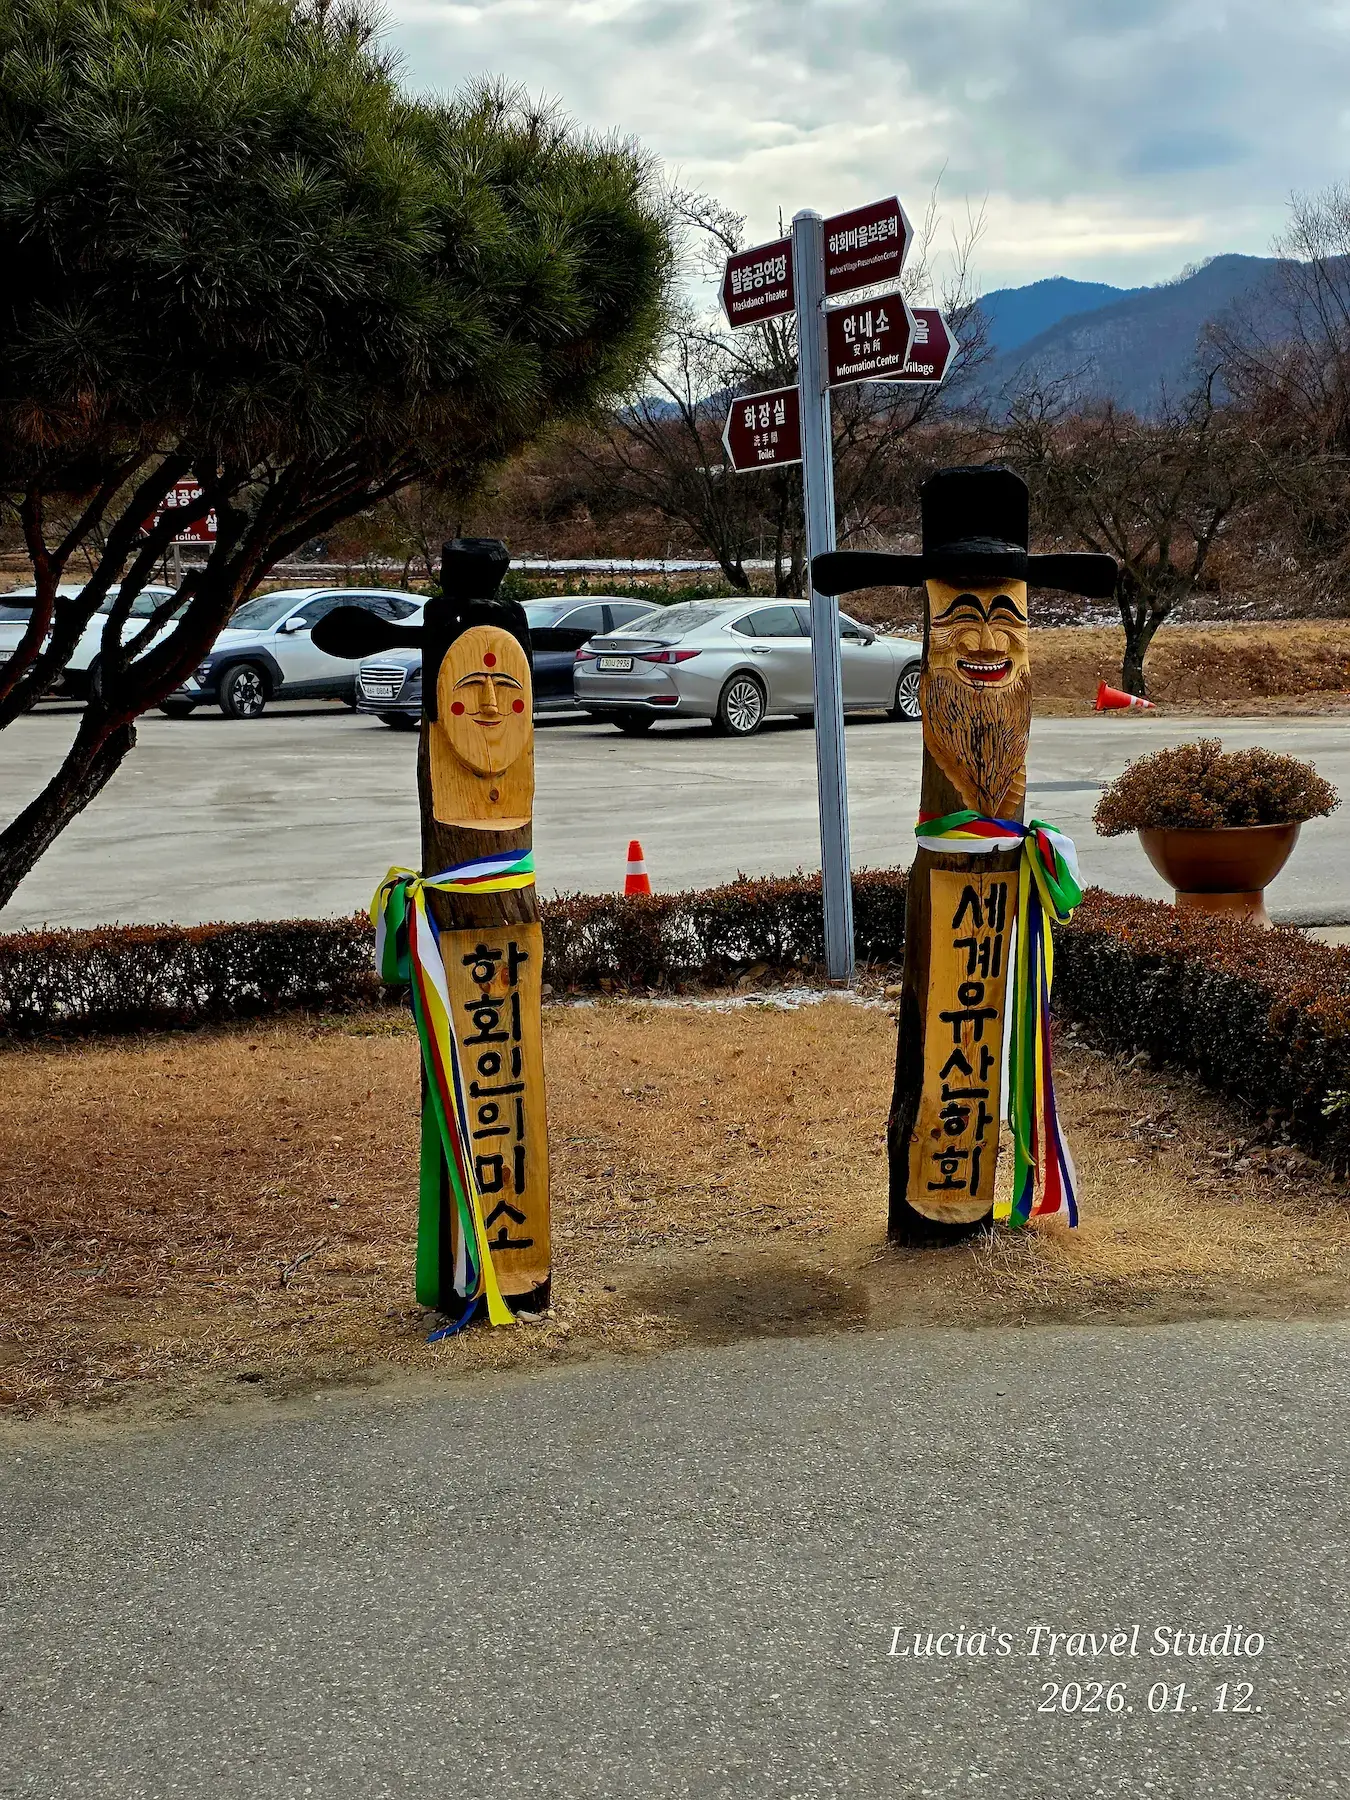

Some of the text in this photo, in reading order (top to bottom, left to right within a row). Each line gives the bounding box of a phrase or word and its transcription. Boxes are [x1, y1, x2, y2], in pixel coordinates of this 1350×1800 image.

[829, 215, 898, 255] 하회마을보존회
[883, 250, 899, 261] Center
[731, 254, 787, 295] 탈춤공연장
[732, 289, 788, 312] Maskdance Theater
[843, 308, 890, 344] 안내소
[836, 354, 900, 377] Information Center
[904, 361, 934, 376] Village
[744, 398, 786, 430] 화장실
[757, 448, 775, 460] Toilet
